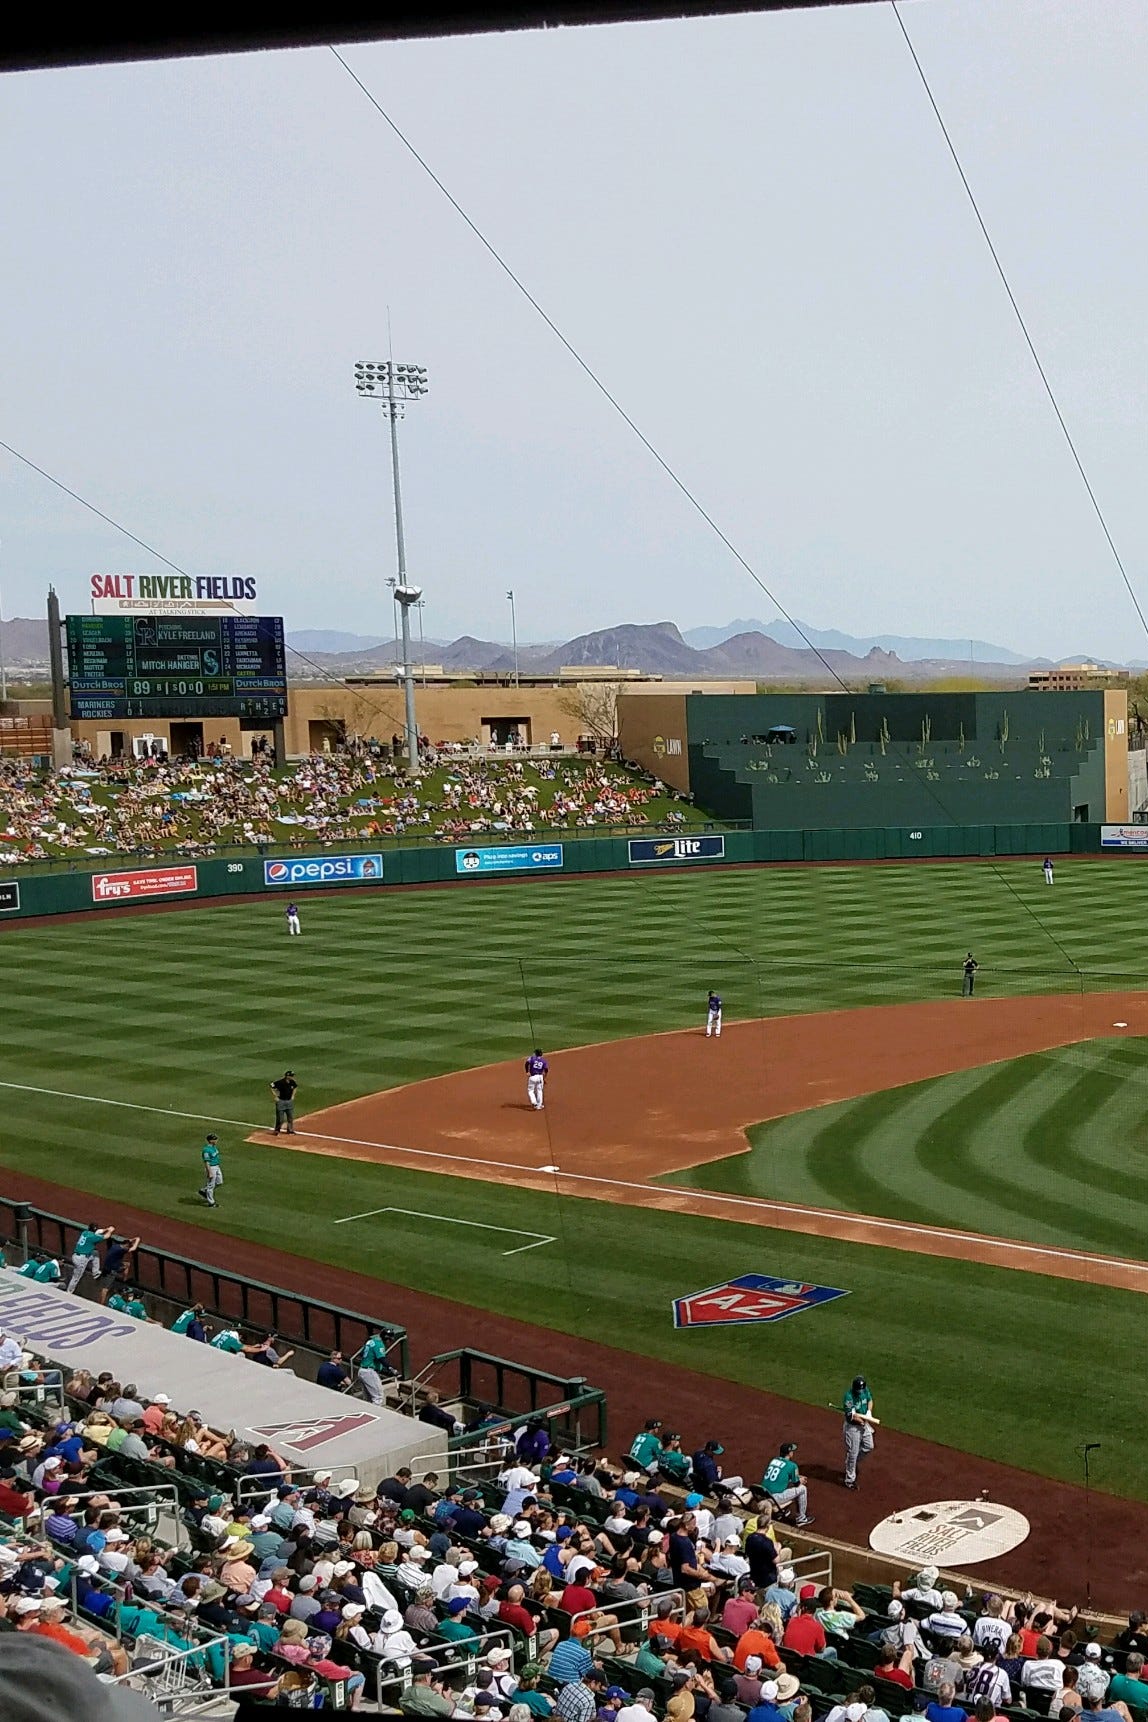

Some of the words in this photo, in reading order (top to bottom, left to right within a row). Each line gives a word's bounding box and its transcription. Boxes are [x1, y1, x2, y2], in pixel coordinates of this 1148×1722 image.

[91, 575, 135, 599] SALT
[139, 575, 192, 599] RIVER
[196, 576, 256, 600] FIELDS
[158, 631, 176, 640] KYLE
[178, 631, 216, 640] FREELAND
[142, 661, 166, 670] MITCH
[167, 661, 200, 670] HANIGER
[133, 681, 150, 695] 89
[172, 683, 178, 692] S
[179, 681, 187, 695] 0
[195, 681, 204, 695] 0
[77, 701, 116, 709] MARINERS
[240, 703, 246, 711] R
[255, 702, 262, 711] H
[272, 702, 277, 710] E
[81, 710, 113, 718] ROCKIES
[909, 831, 922, 840] 410
[673, 840, 701, 858] Lite
[542, 852, 558, 861] aps
[227, 863, 243, 873] 390
[291, 858, 352, 882] pepsi
[96, 877, 131, 896] fry's
[695, 1293, 788, 1317] AZ
[764, 1466, 780, 1482] 38
[929, 1523, 975, 1541] SALT
[899, 1540, 944, 1556] FIELDS
[913, 1532, 958, 1550] RIVER
[981, 1623, 1003, 1635] RIVERA
